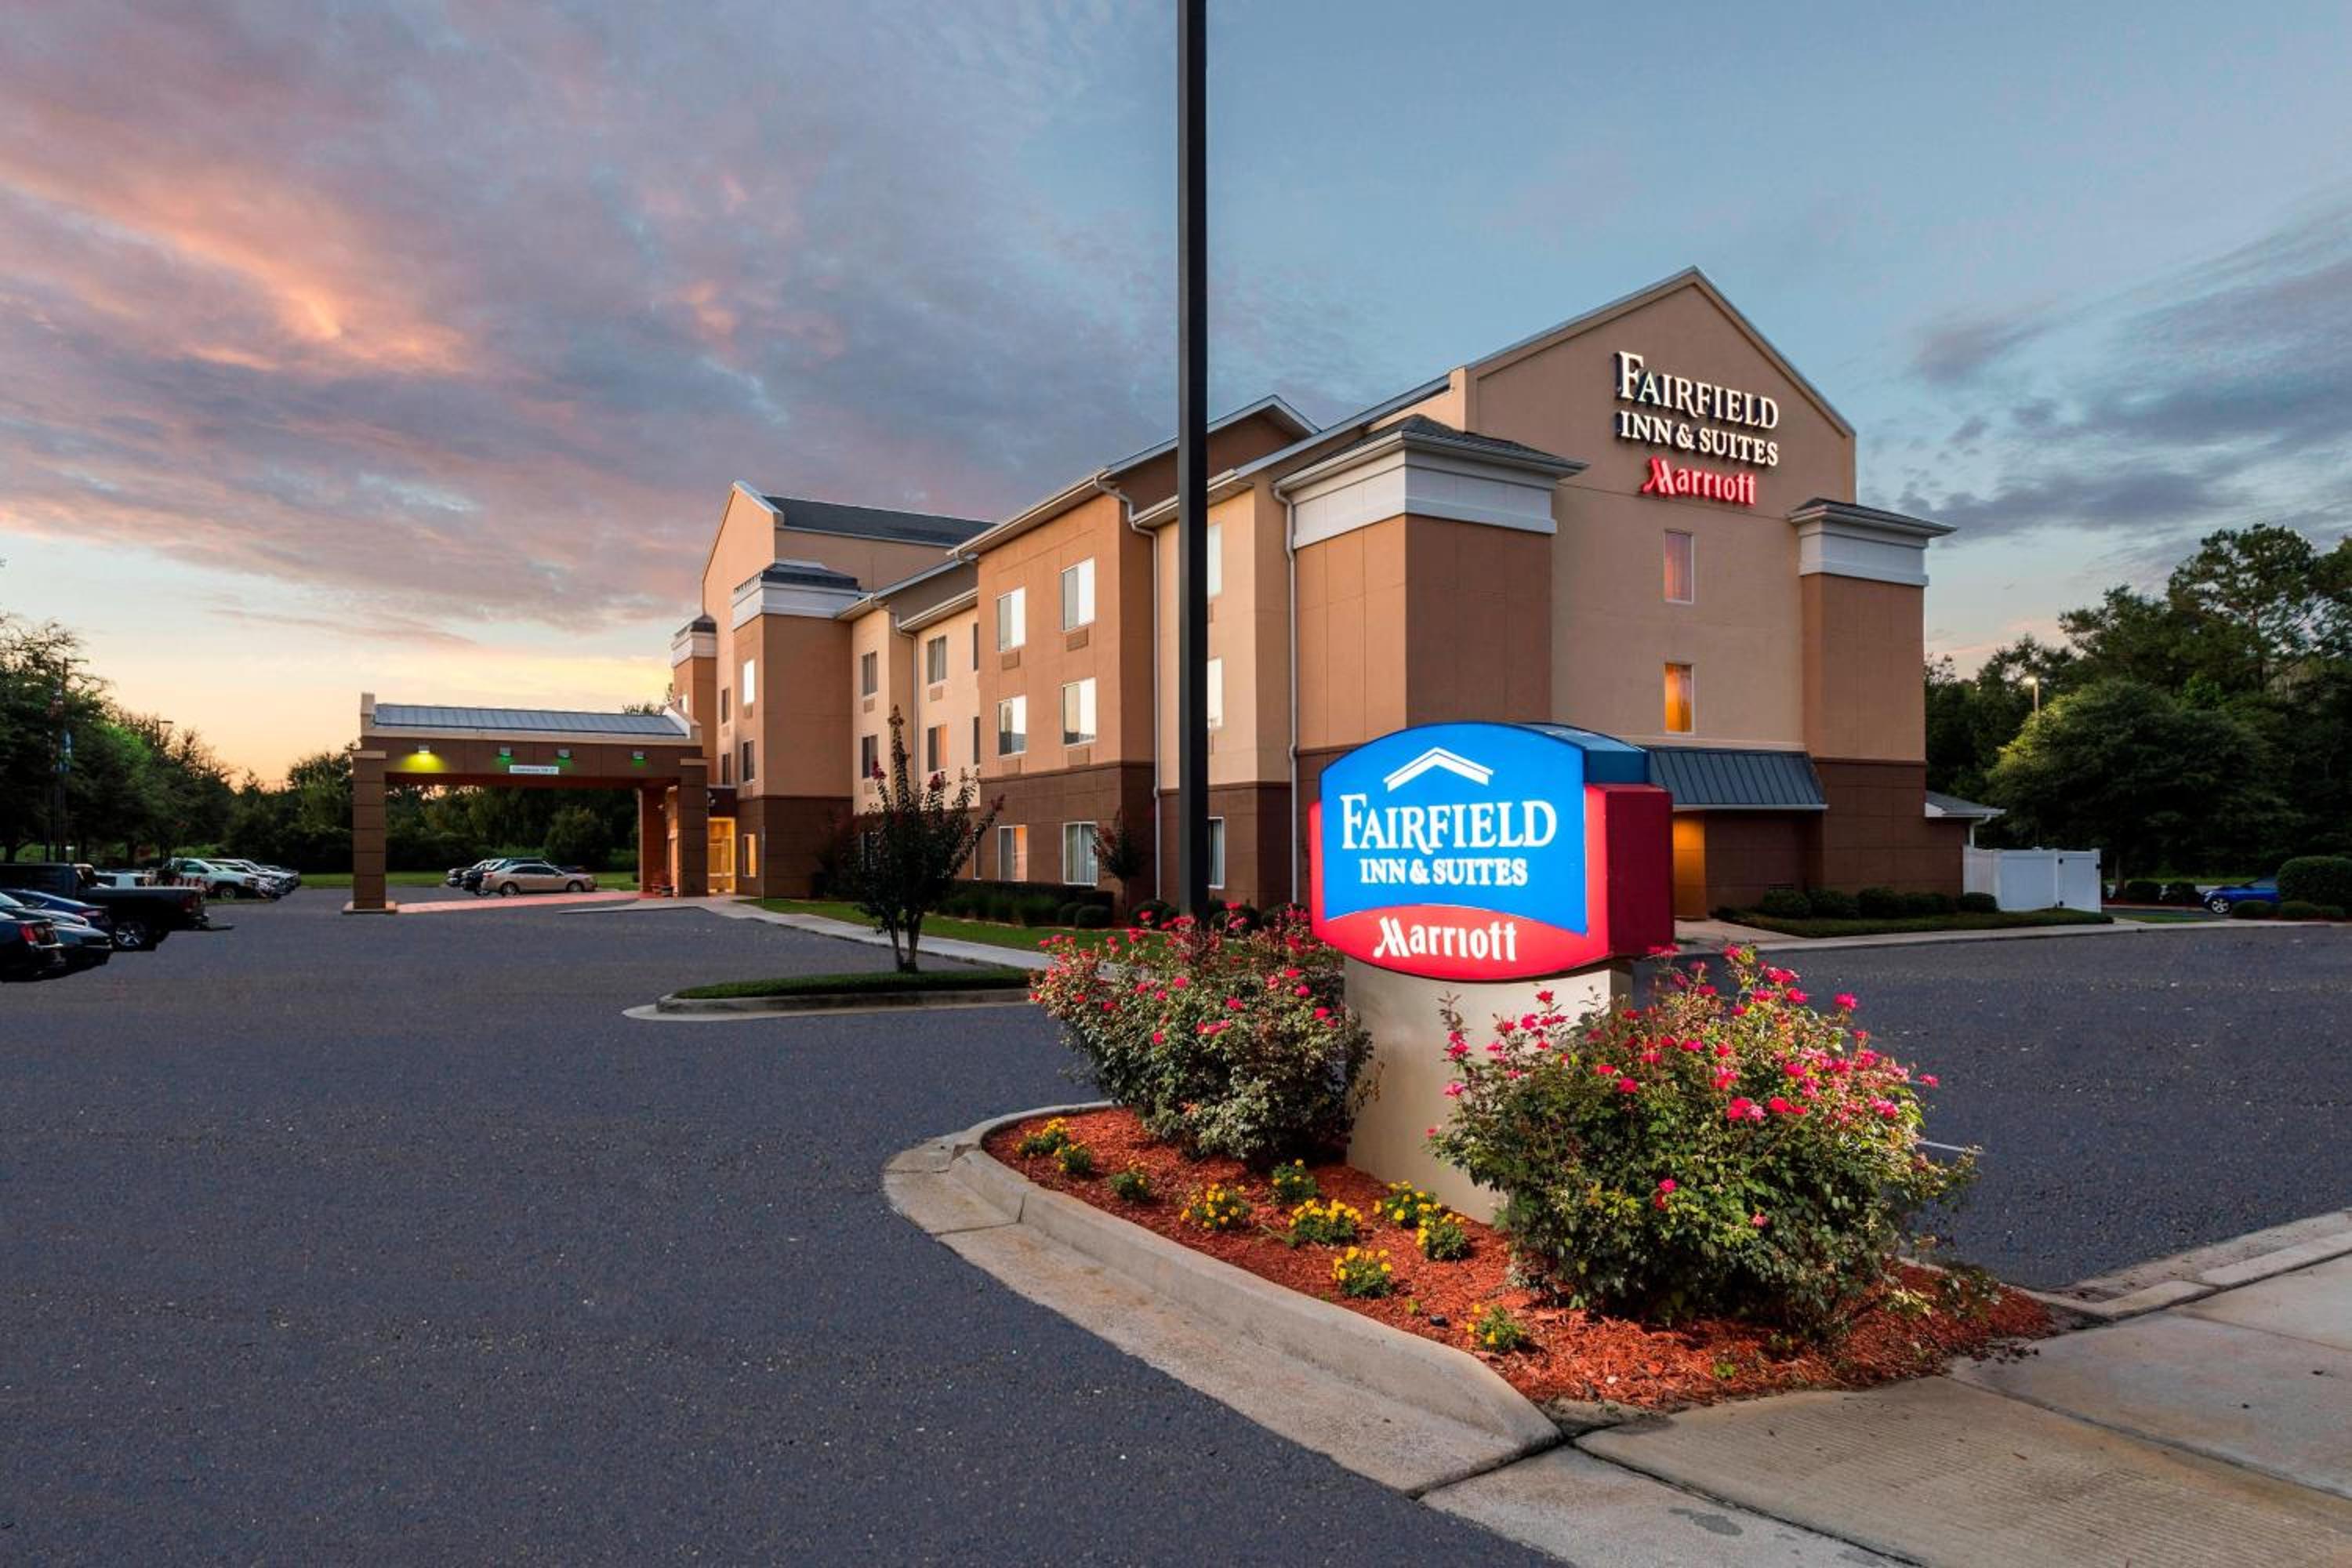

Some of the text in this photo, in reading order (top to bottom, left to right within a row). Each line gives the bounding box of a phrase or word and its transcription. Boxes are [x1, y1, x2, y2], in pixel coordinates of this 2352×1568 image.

[1619, 350, 1779, 429] FAIRFIELD
[1621, 411, 1779, 466] INN & SUITES
[1642, 456, 1755, 504] Marriott
[1340, 793, 1557, 855] FAIRFIELD
[1359, 858, 1529, 887] INN & SUITES
[1373, 916, 1517, 962] Marriott
